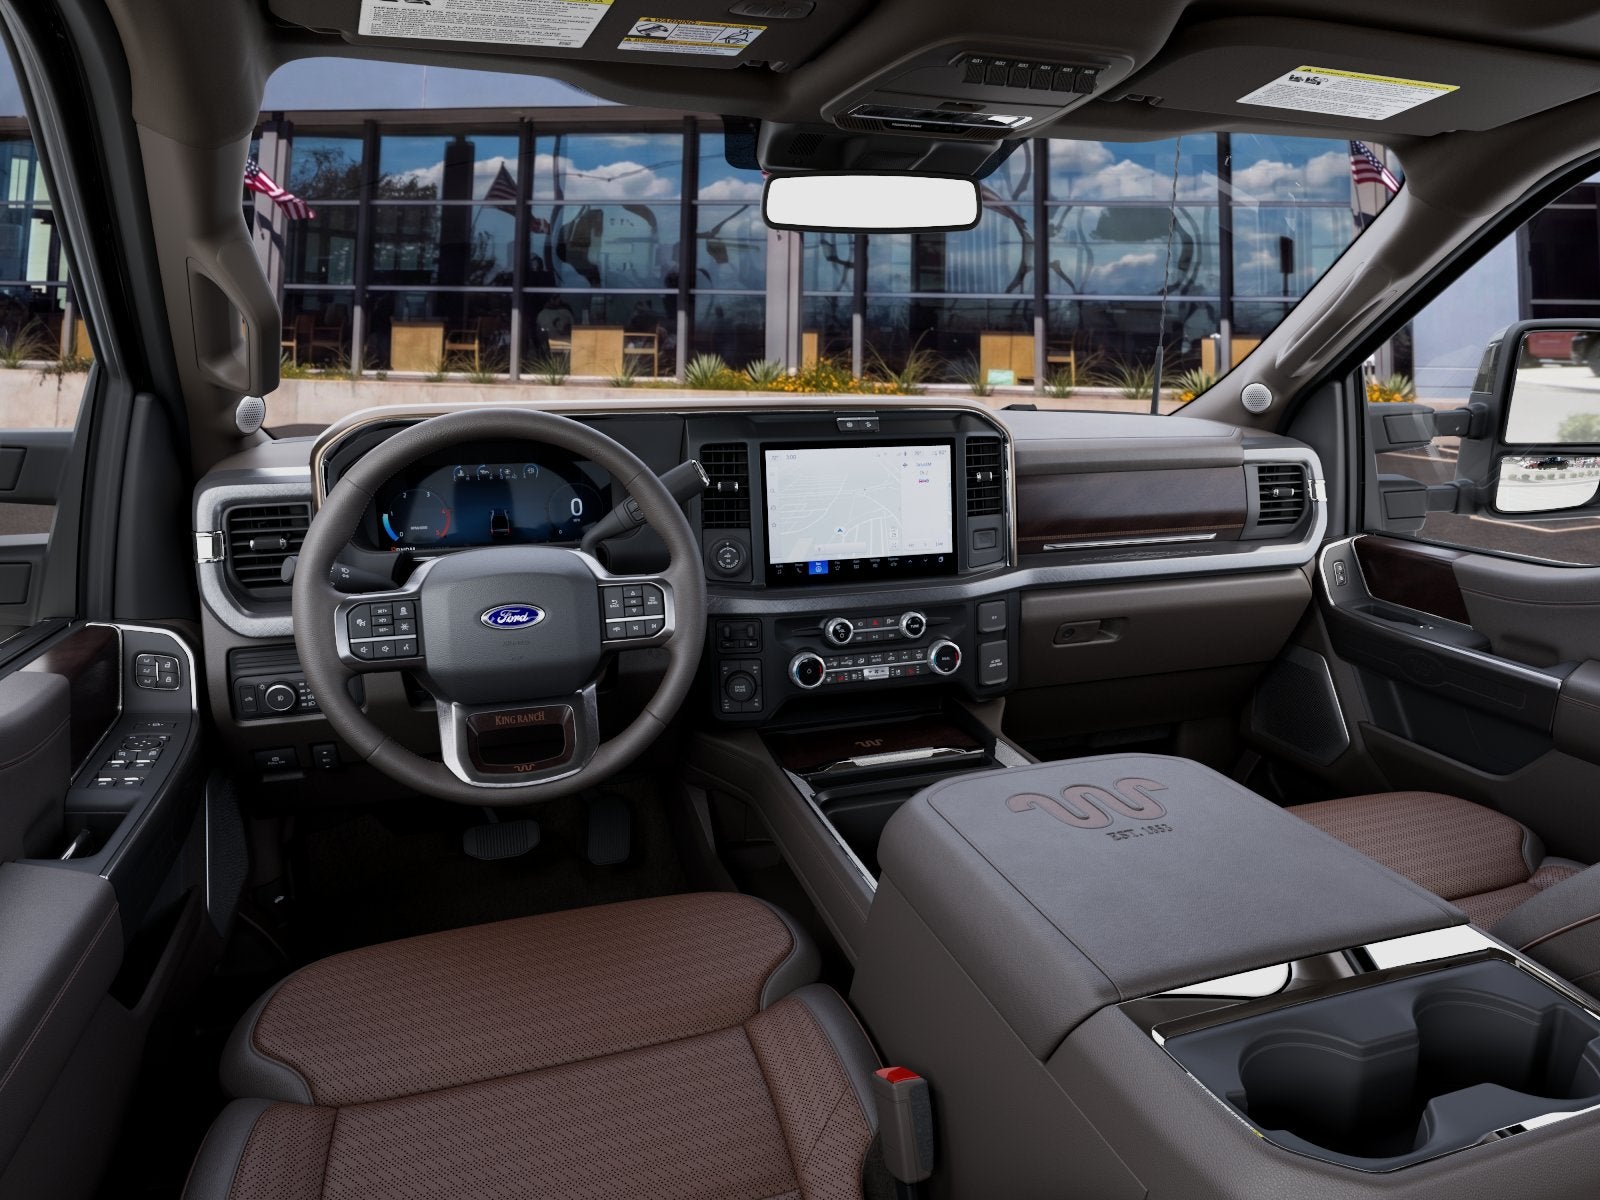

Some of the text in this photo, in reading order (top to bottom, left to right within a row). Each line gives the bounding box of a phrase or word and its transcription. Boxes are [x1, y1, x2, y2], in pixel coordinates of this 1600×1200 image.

[570, 497, 583, 517] 0
[496, 609, 533, 624] Ford
[495, 711, 545, 726] KING RANCH
[1106, 828, 1144, 841] EST.
